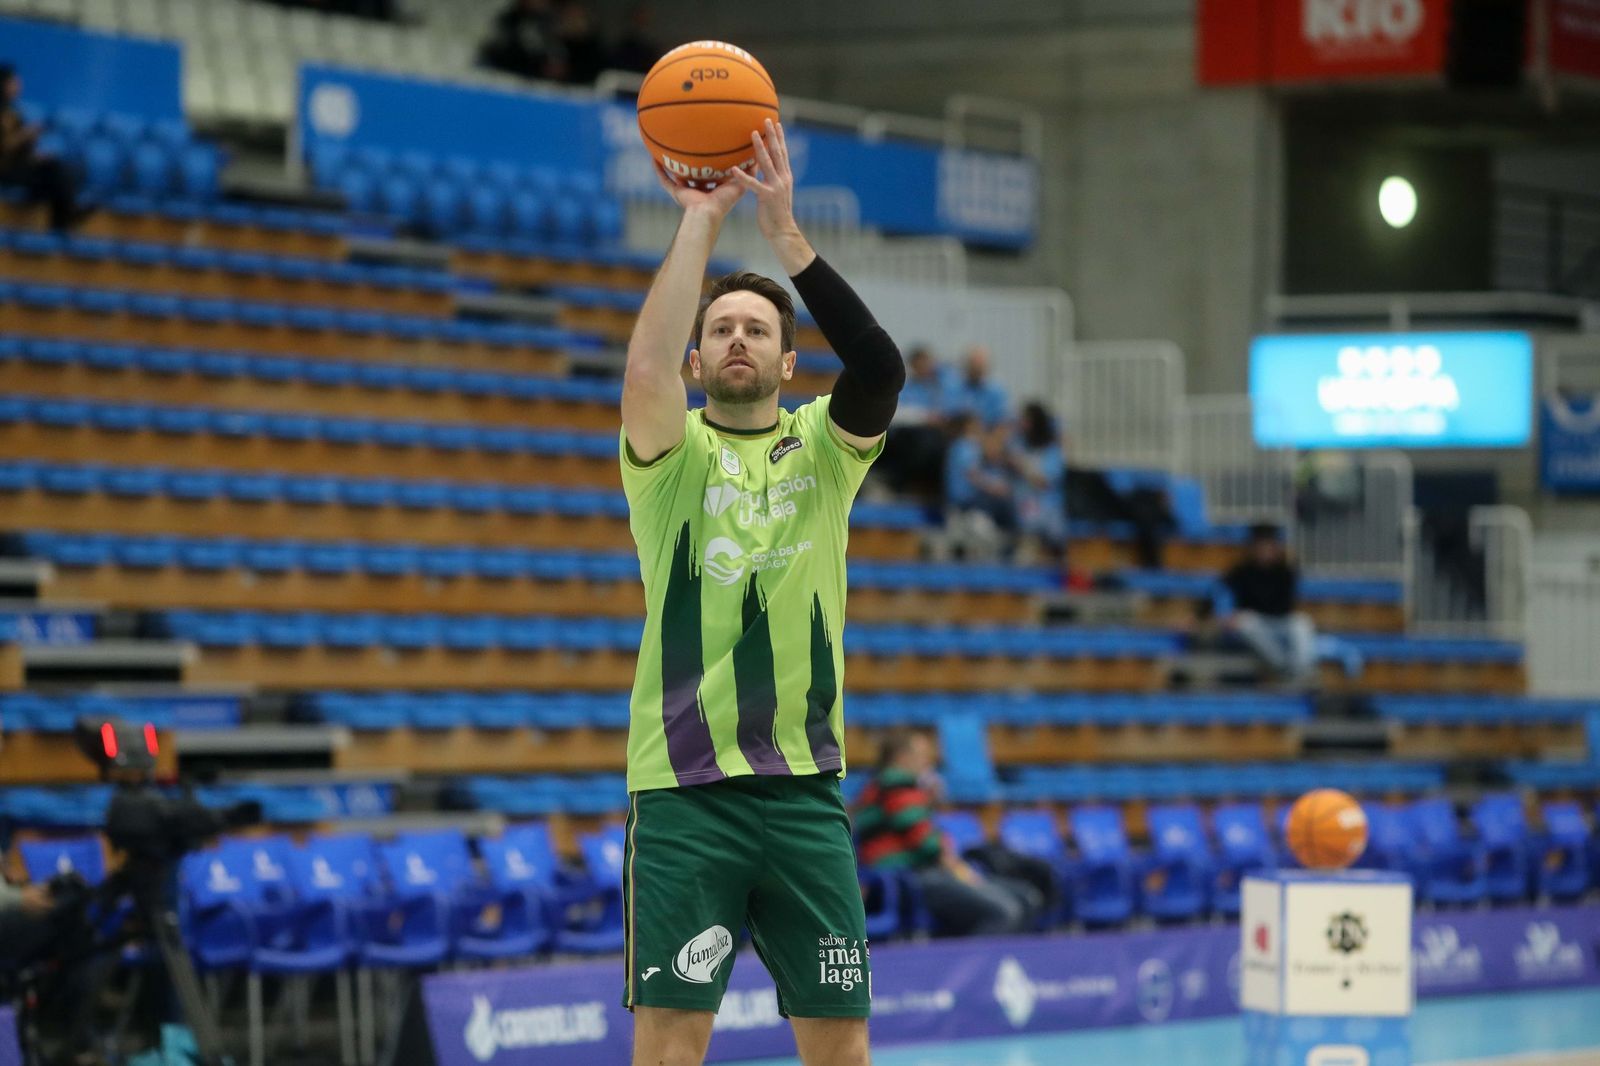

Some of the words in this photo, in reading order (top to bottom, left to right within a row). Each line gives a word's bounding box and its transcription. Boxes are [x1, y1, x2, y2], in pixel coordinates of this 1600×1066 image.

[741, 474, 816, 510] Funación
[818, 934, 848, 946] sabor
[819, 962, 863, 991] laga
